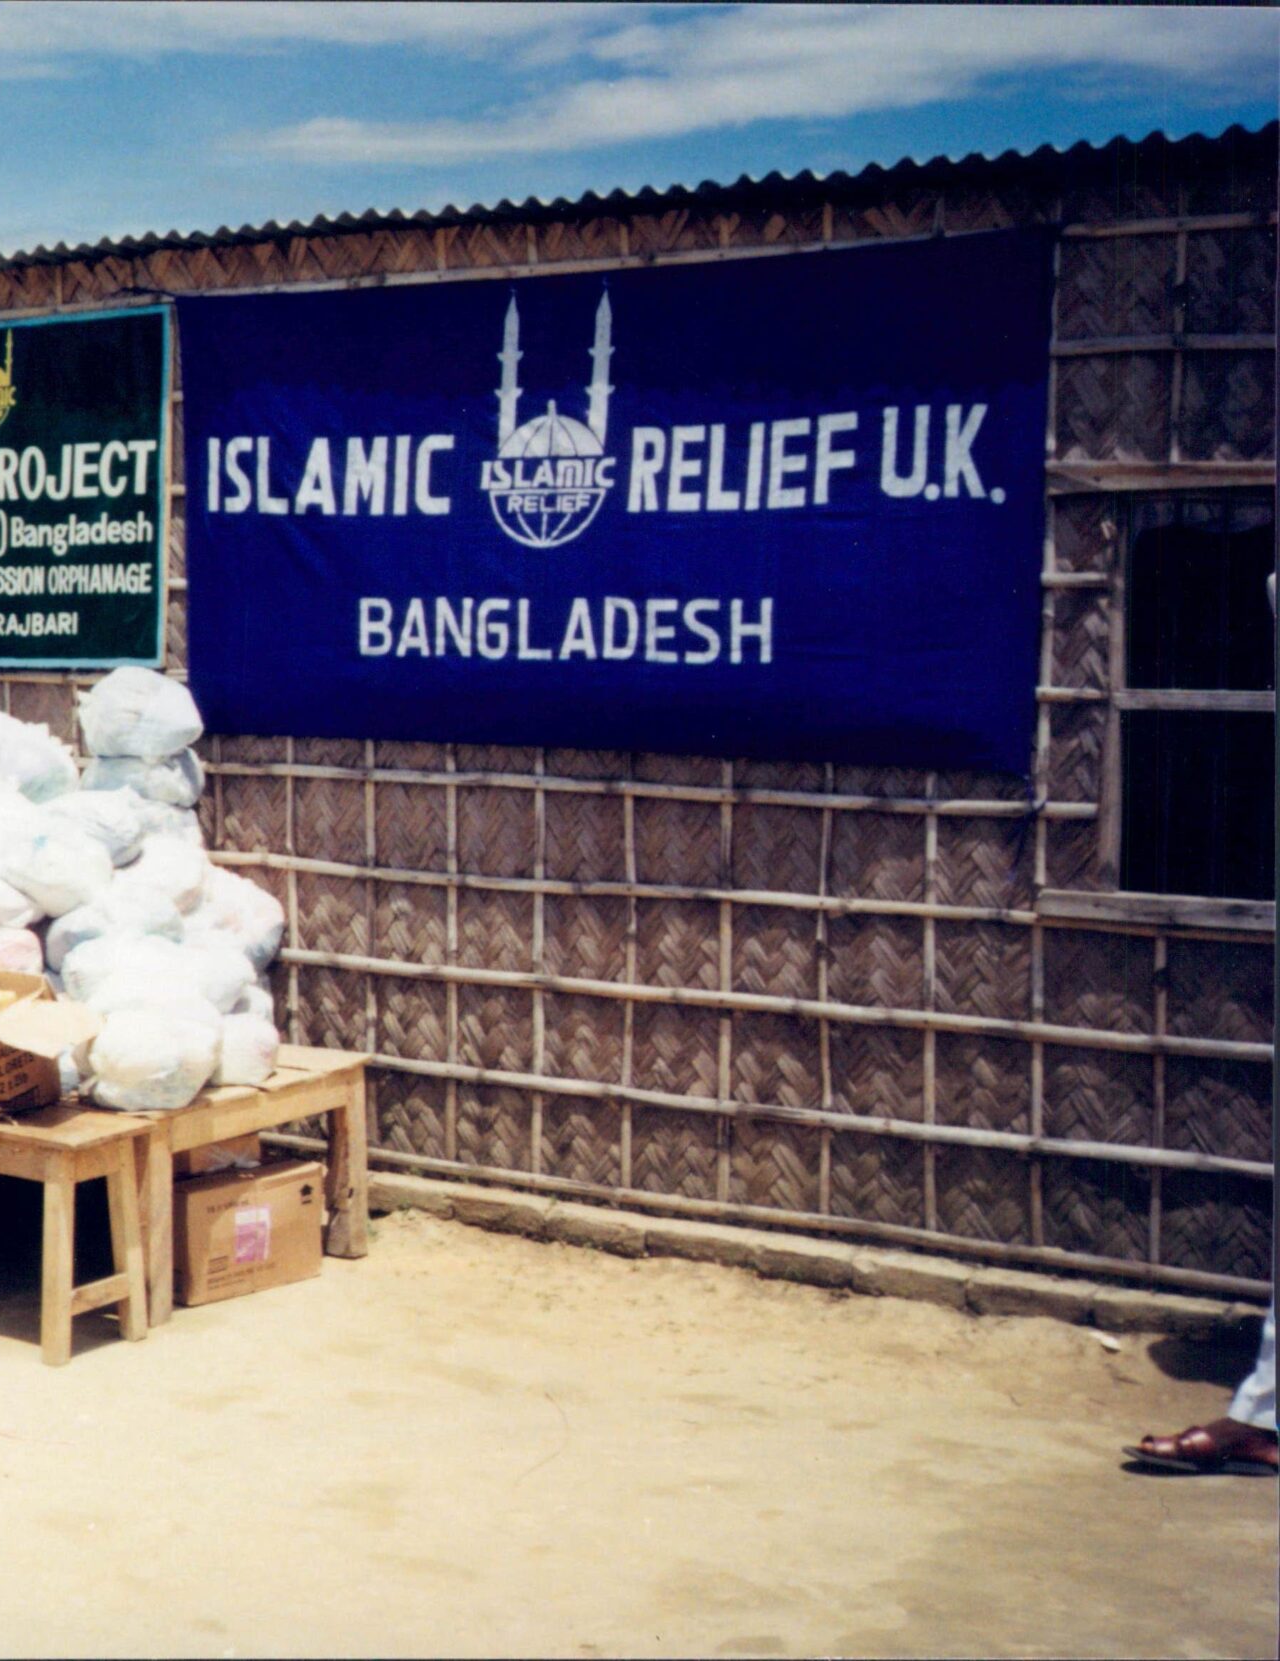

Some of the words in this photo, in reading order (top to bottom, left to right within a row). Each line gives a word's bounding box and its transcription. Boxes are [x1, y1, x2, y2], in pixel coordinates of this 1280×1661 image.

[208, 434, 454, 516] ISLAMIC
[626, 411, 859, 513] RELIEF
[880, 403, 1006, 504] U.K.
[480, 457, 616, 490] ISLAMIC
[507, 494, 591, 514] RELIEF
[10, 510, 153, 557] Bangladesh
[48, 563, 153, 595] ORPHANAGE
[358, 596, 774, 665] BANGLADESH
